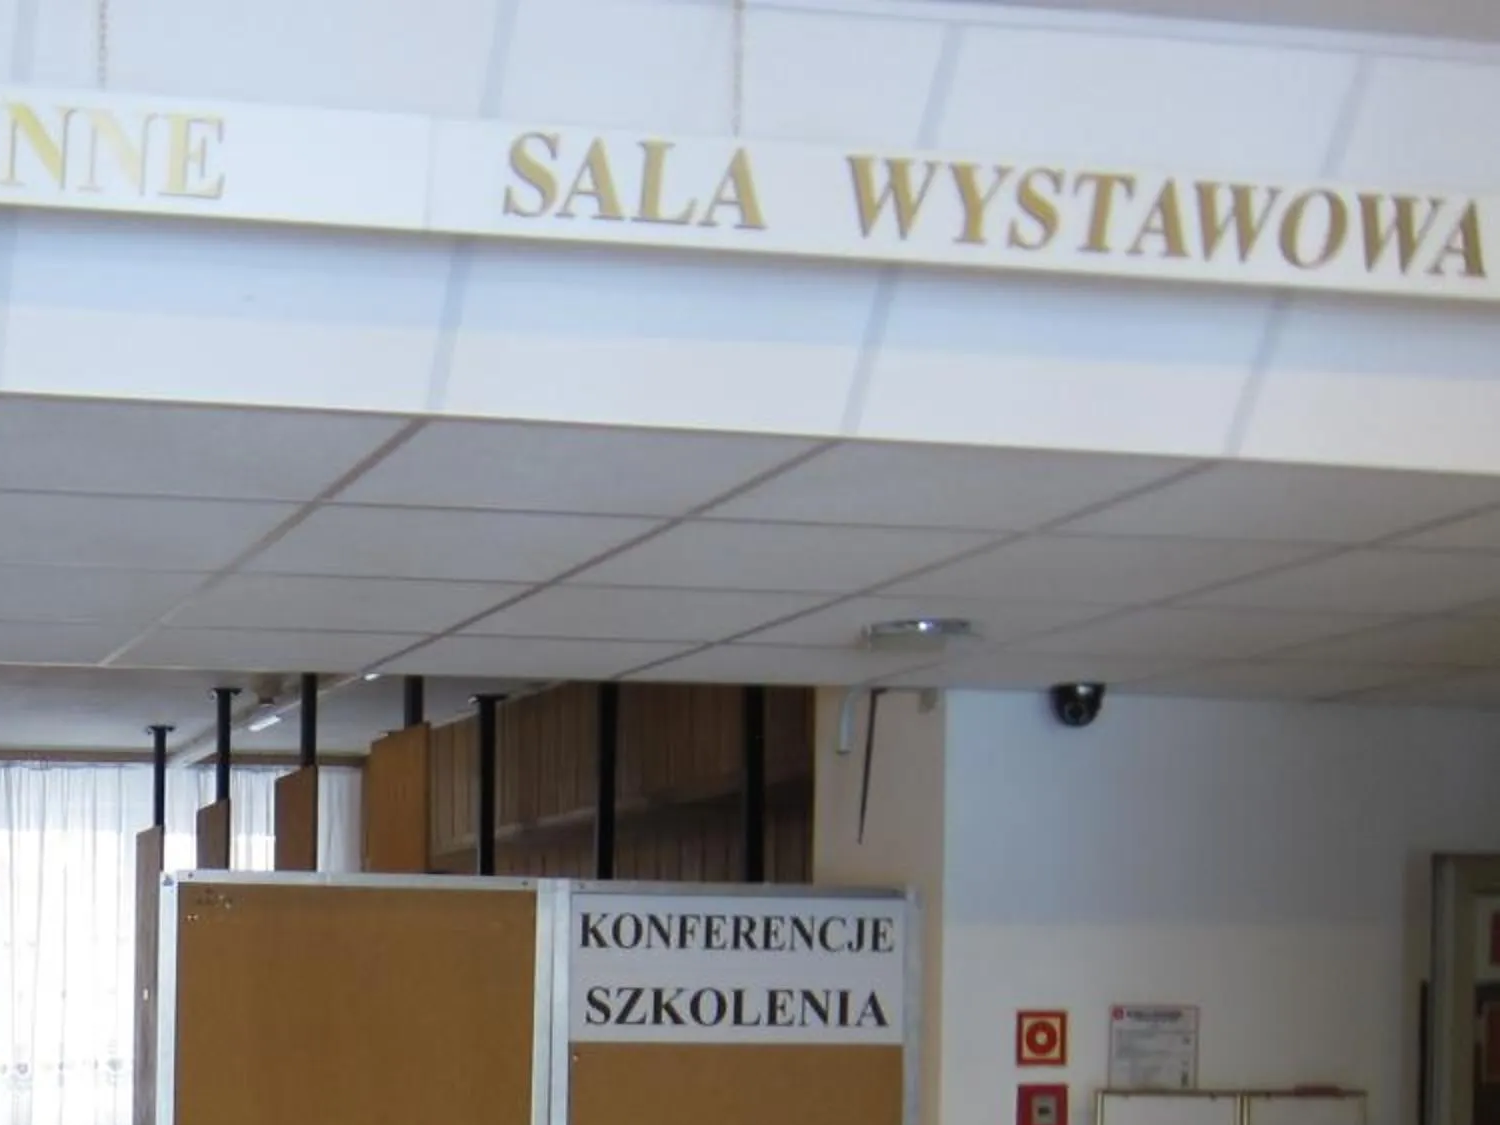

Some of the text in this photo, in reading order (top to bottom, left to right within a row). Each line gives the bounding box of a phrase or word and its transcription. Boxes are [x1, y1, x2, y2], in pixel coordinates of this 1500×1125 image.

[502, 131, 1489, 278] SALA WYSTAWOWA
[579, 911, 895, 953] KONFERENCJE
[584, 986, 890, 1028] SZKOLENIA
